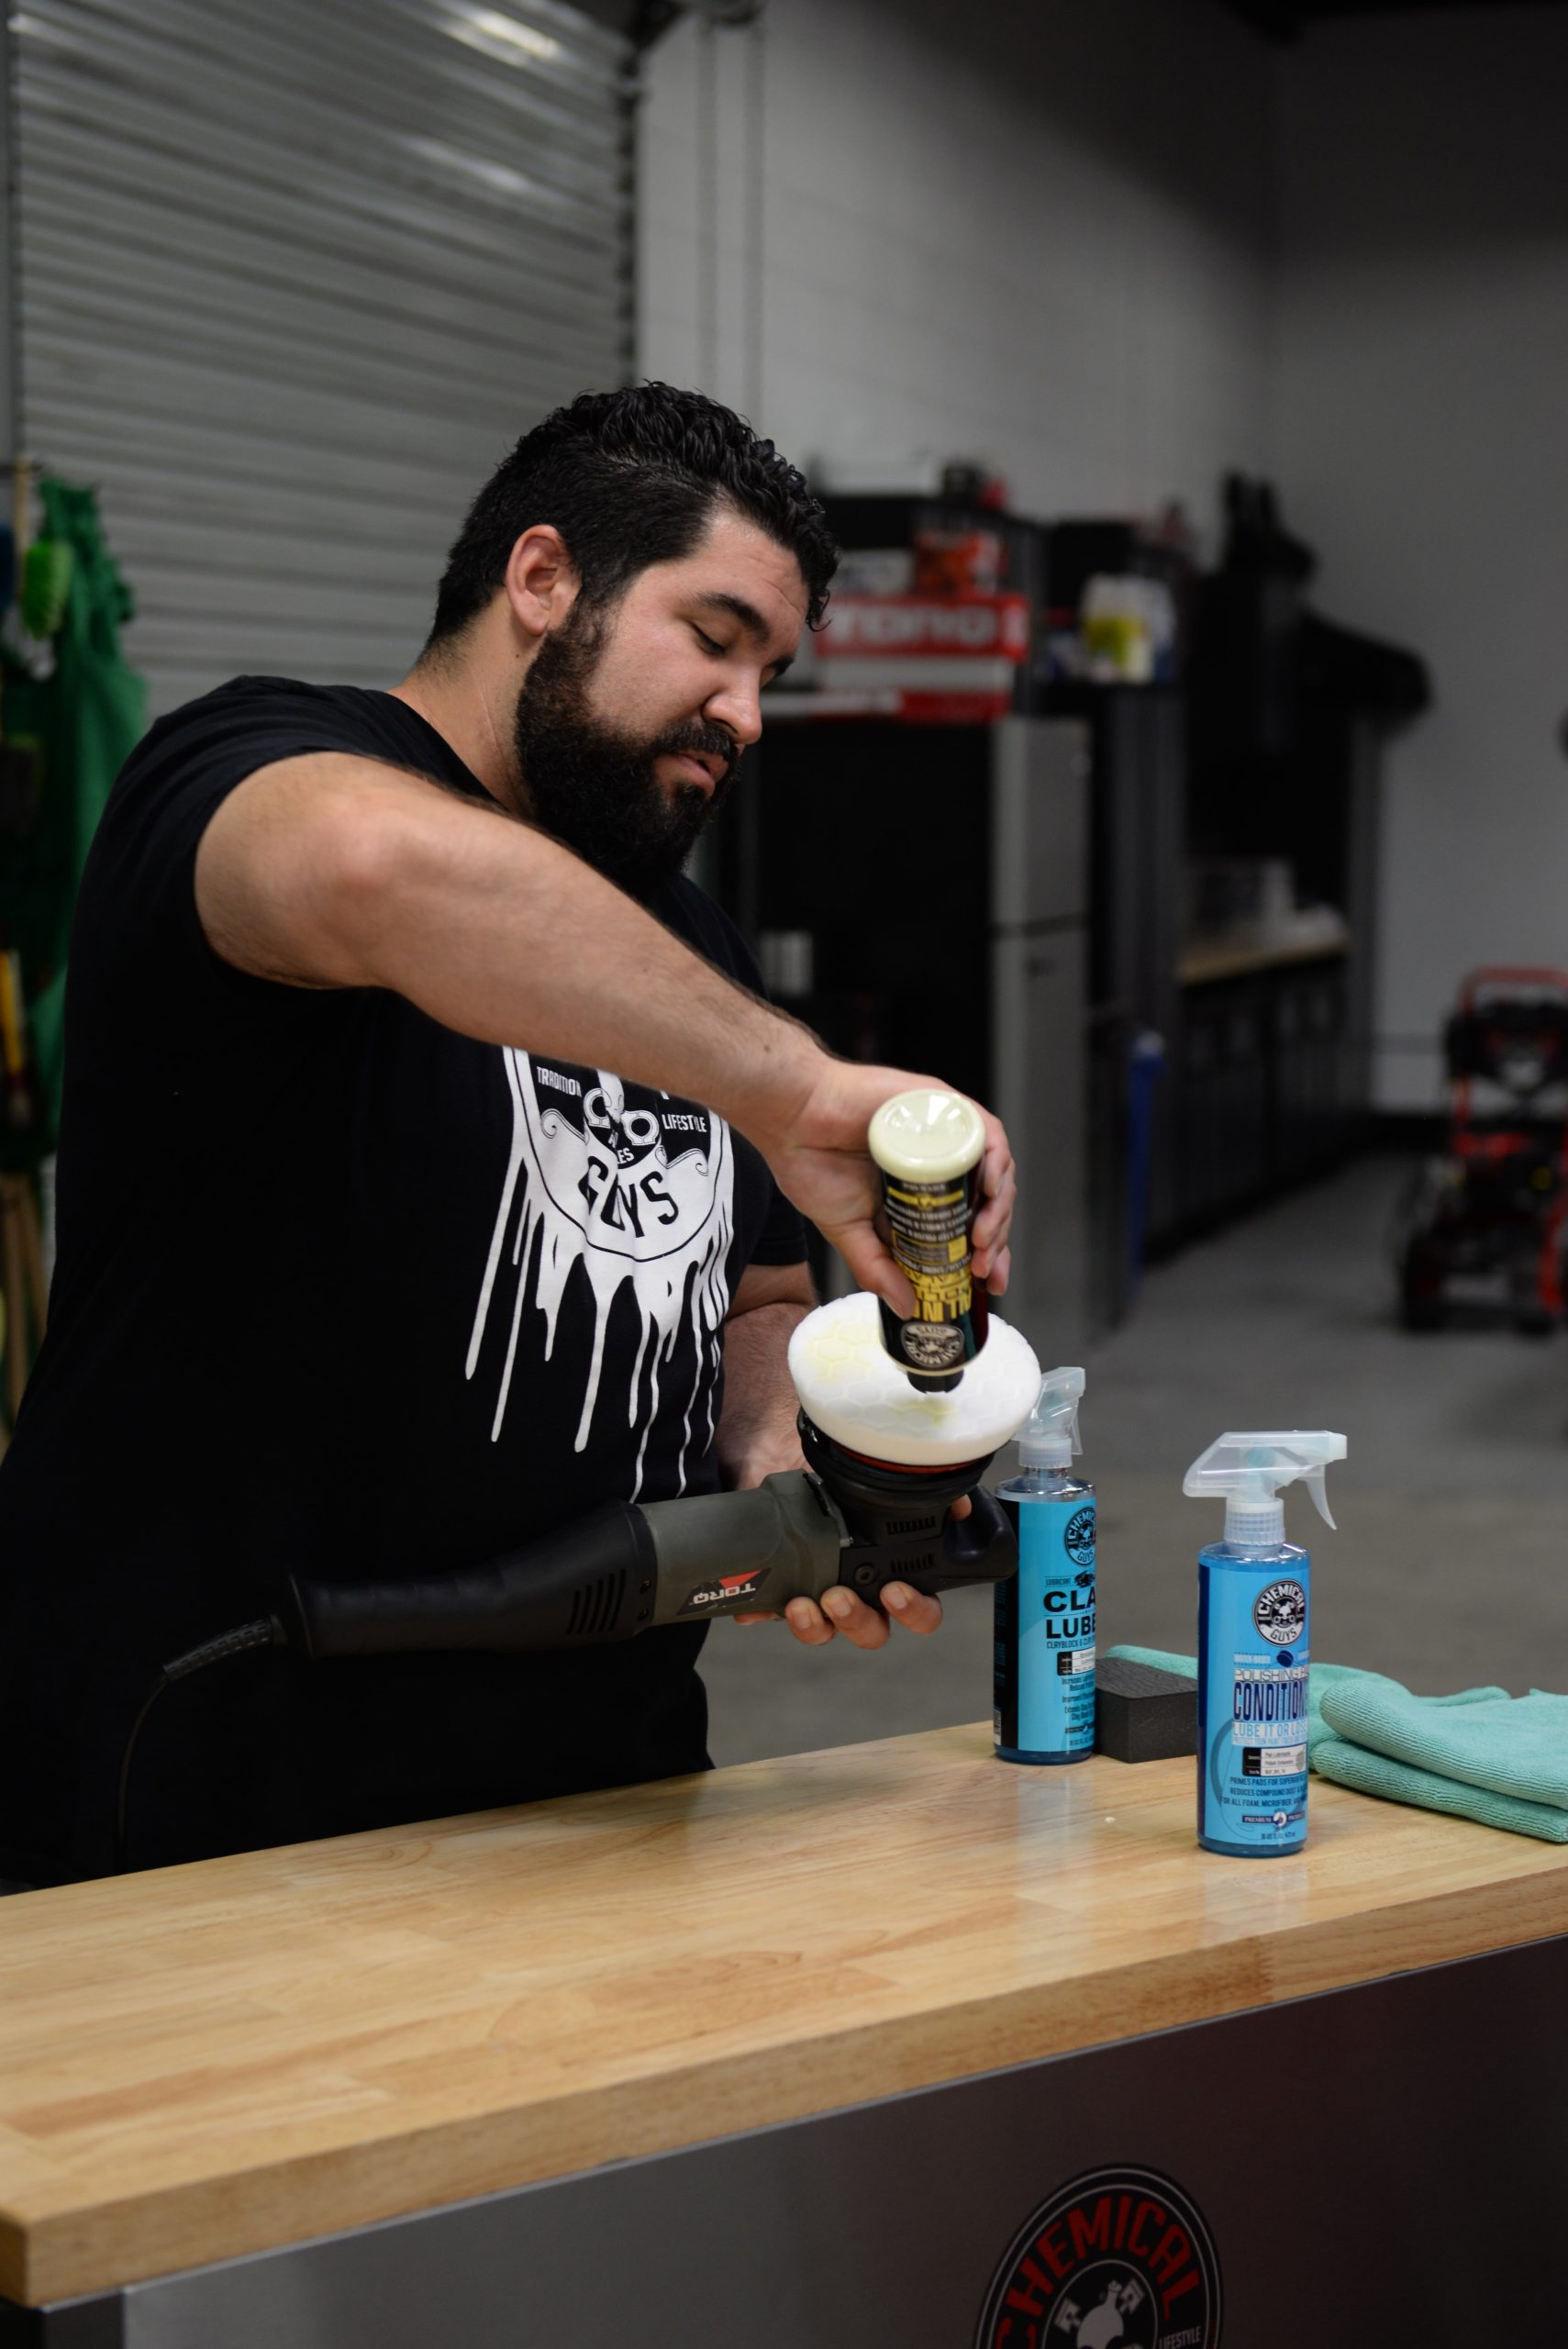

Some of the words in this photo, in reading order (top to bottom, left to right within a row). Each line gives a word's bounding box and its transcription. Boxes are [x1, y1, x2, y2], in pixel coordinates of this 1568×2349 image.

[693, 1583, 756, 1604] TORQ
[1043, 1586, 1095, 1613] CLA
[1258, 1585, 1305, 1614] CHEMICAL
[1271, 1628, 1296, 1642] GUYS
[1234, 1680, 1307, 1721] CONDITION
[994, 2195, 1200, 2349] CHEMICAL
